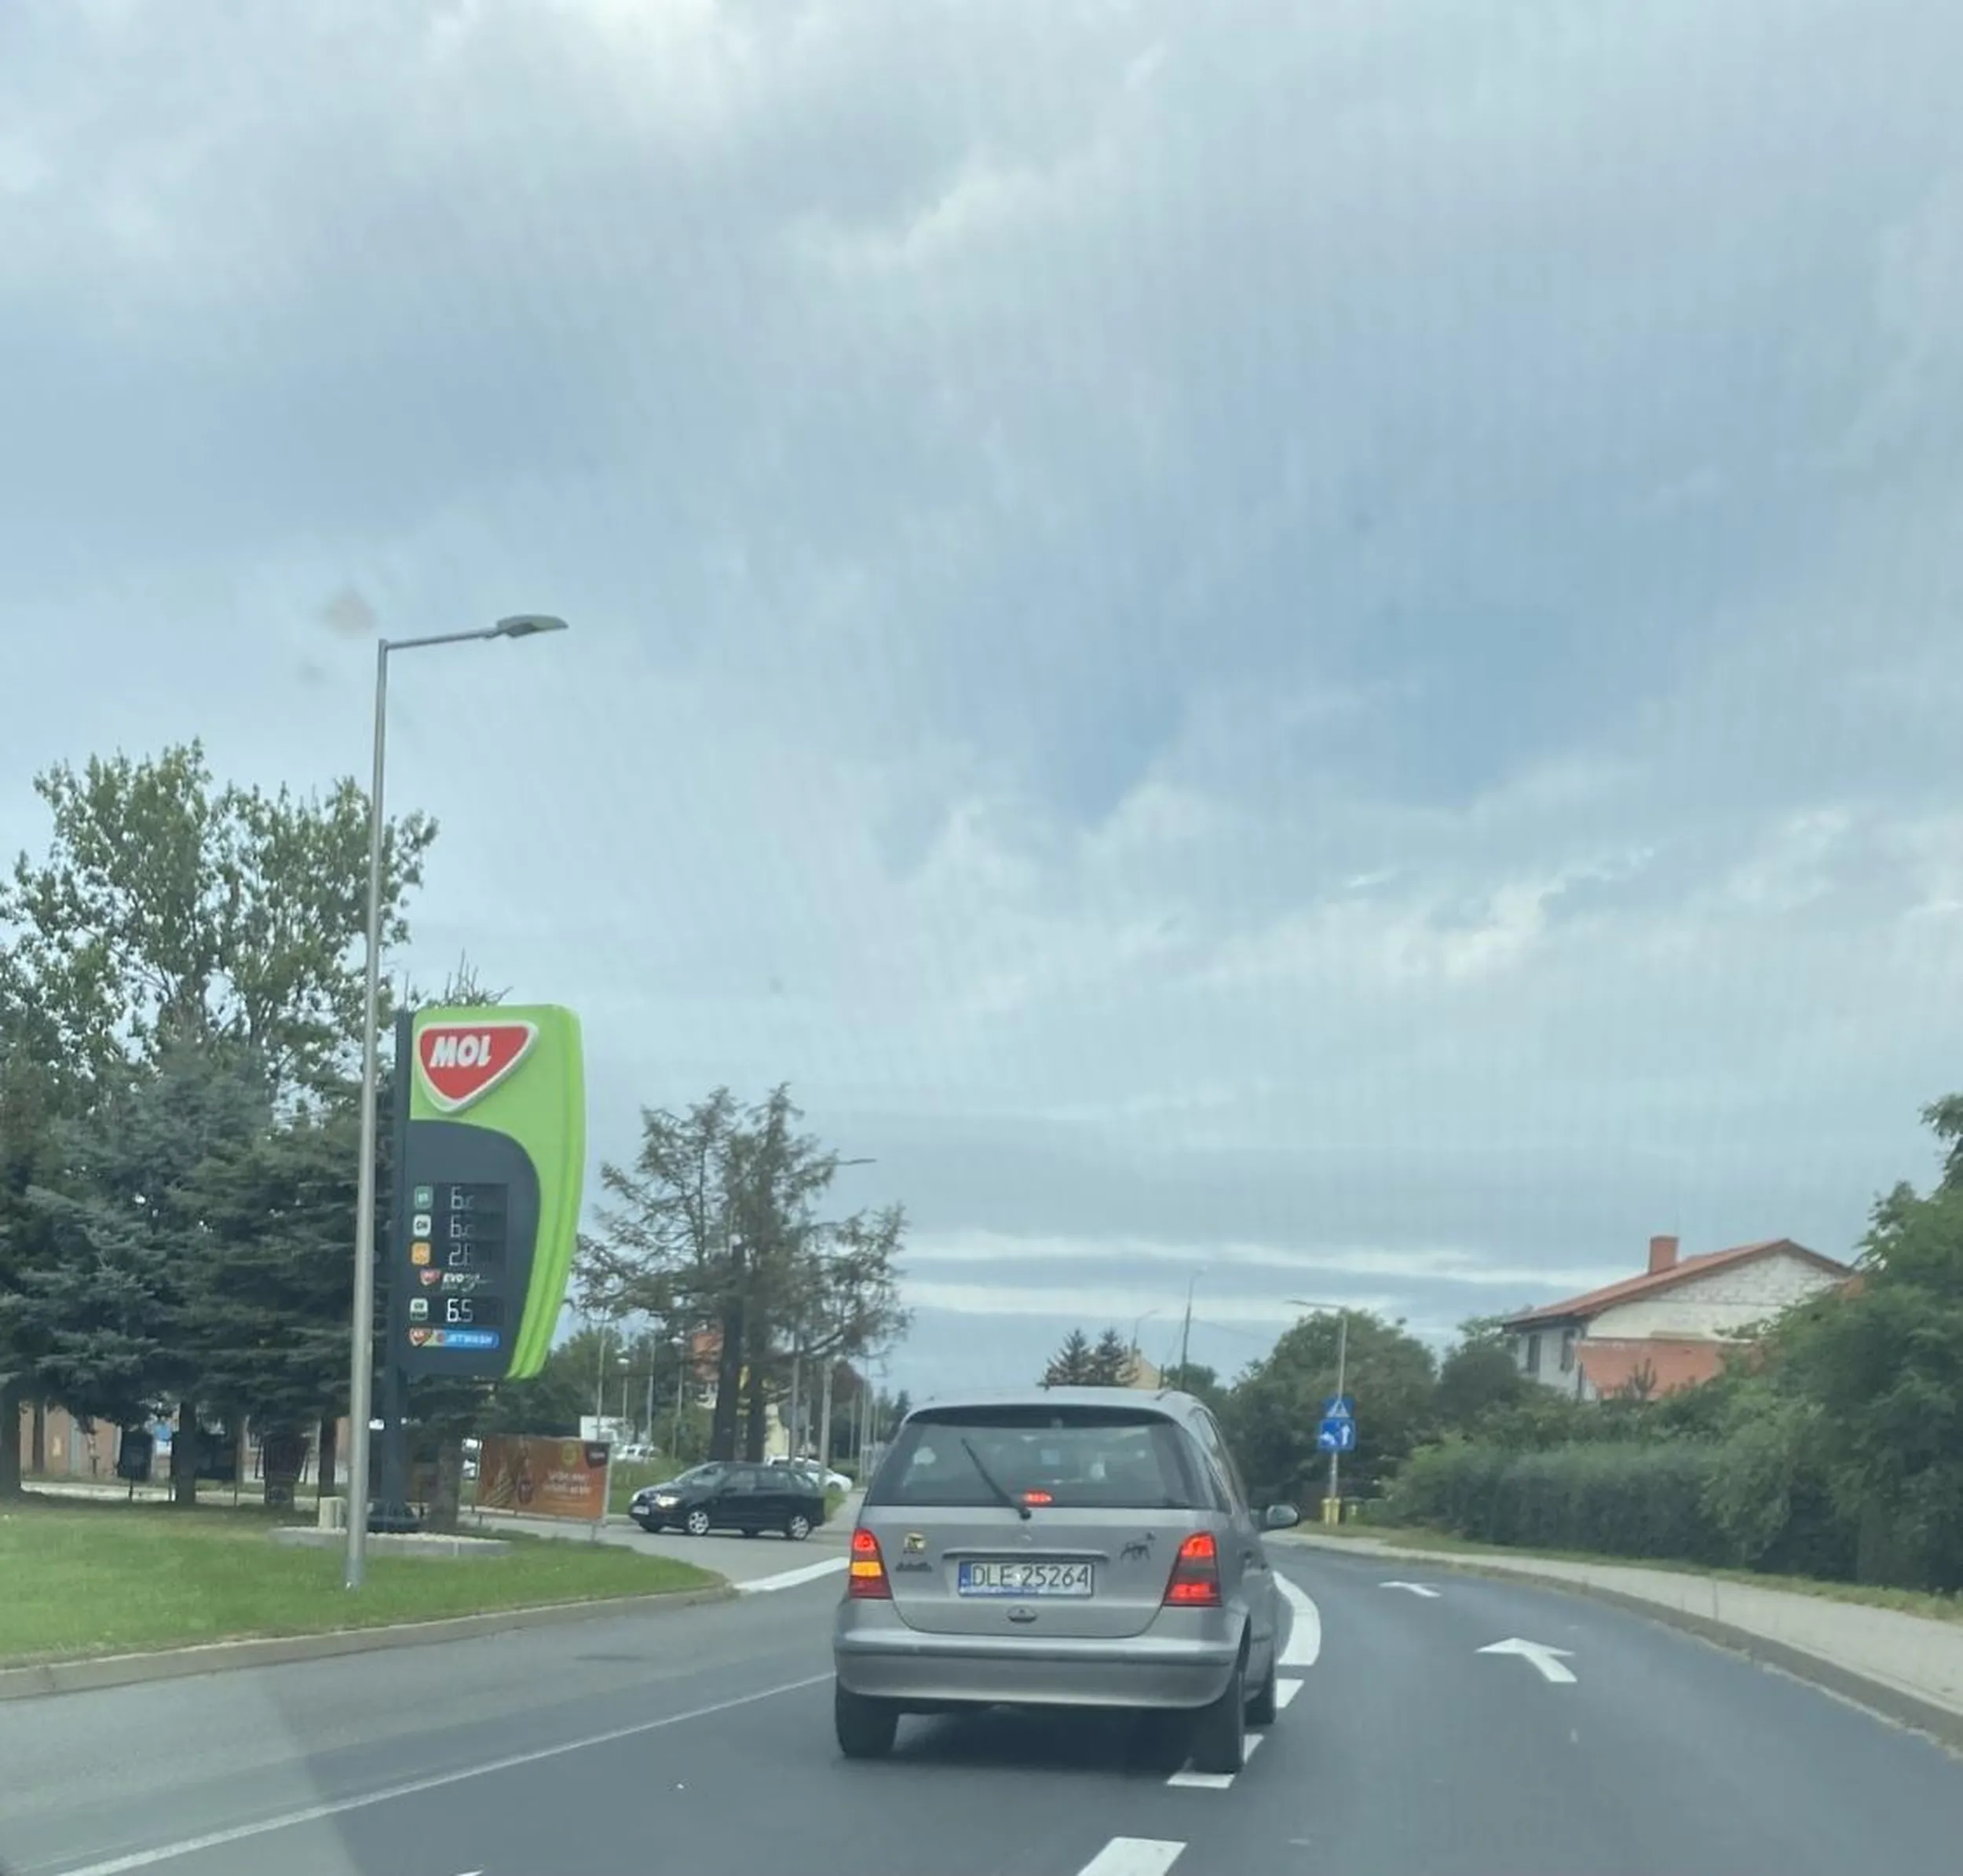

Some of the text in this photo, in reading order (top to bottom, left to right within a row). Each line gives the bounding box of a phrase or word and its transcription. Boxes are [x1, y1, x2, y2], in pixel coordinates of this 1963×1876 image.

[430, 1034, 492, 1067] MOL
[972, 1565, 1089, 1588] DLE 25264
